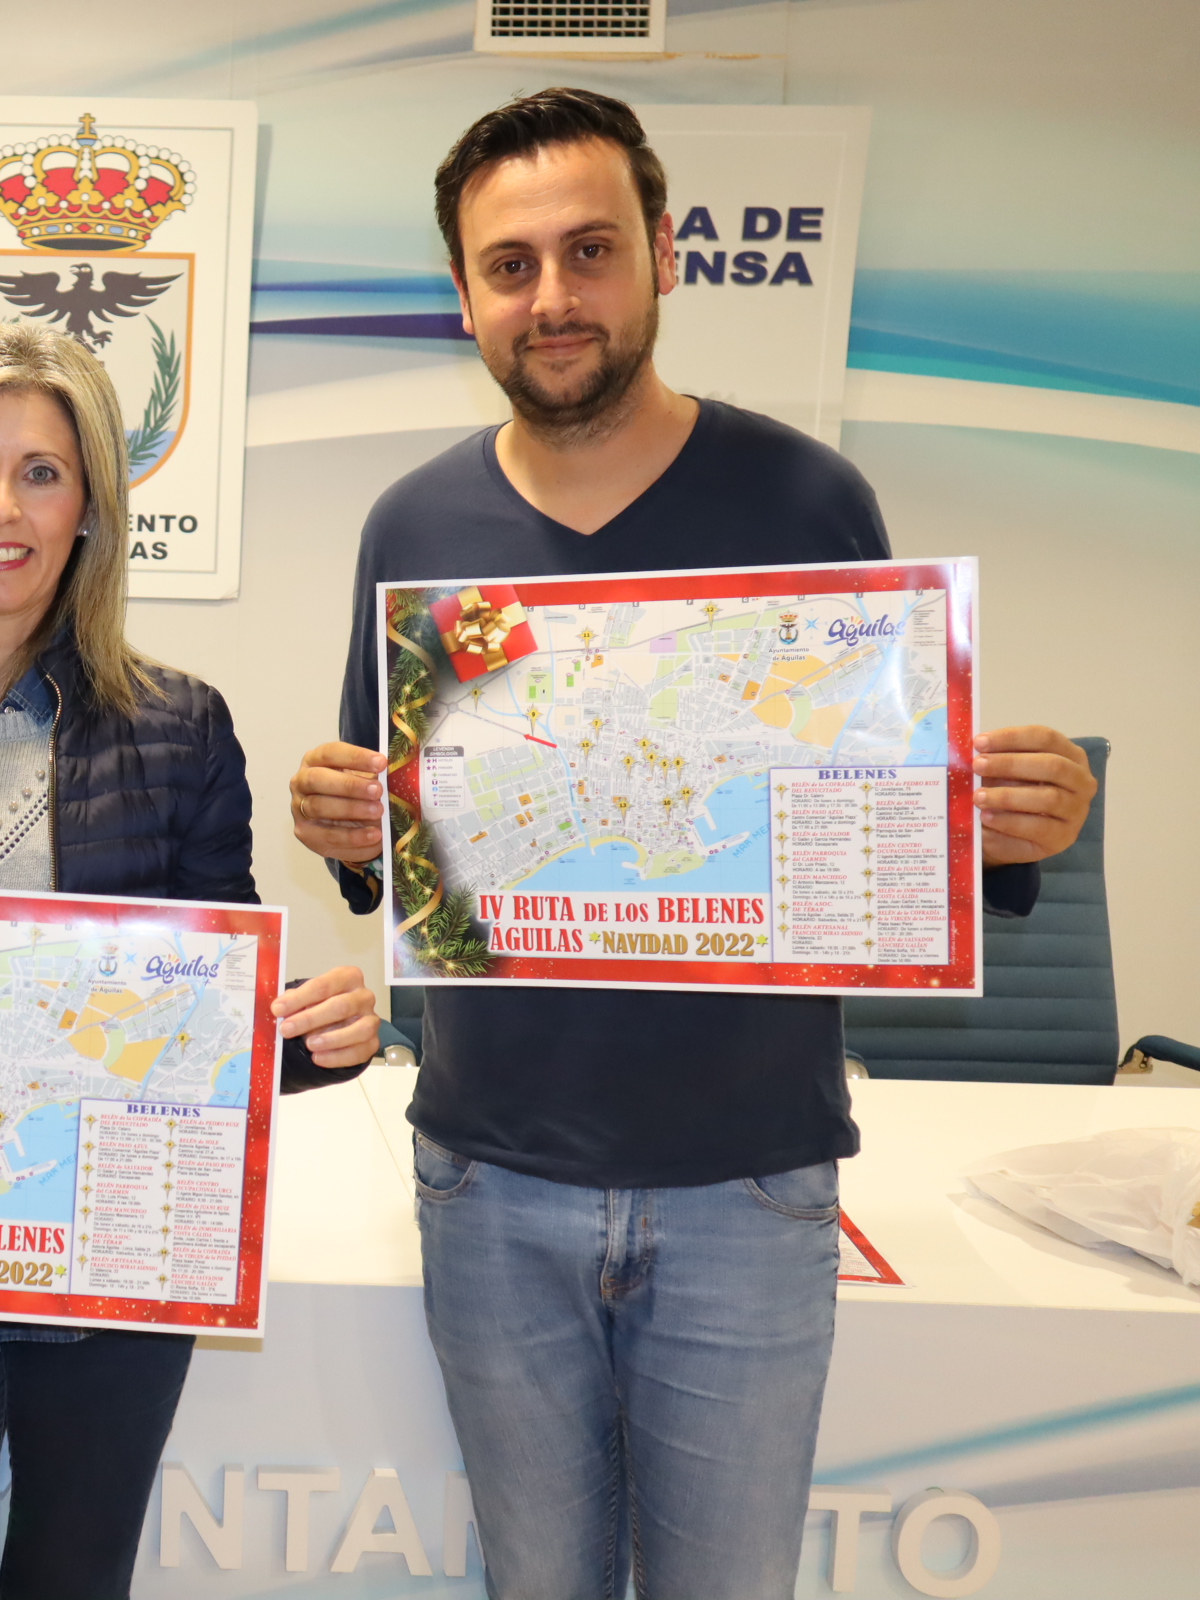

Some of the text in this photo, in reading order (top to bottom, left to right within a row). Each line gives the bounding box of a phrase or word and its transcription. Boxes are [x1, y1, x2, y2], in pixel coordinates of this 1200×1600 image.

[742, 207, 824, 241] DE
[675, 251, 813, 286] NSA
[818, 769, 897, 780] BELENES
[479, 895, 765, 925] IV RUTA DE LOS BELENES
[490, 922, 755, 956] ÁGUILAS NAVIDAD 2022
[127, 1104, 201, 1118] BELENES
